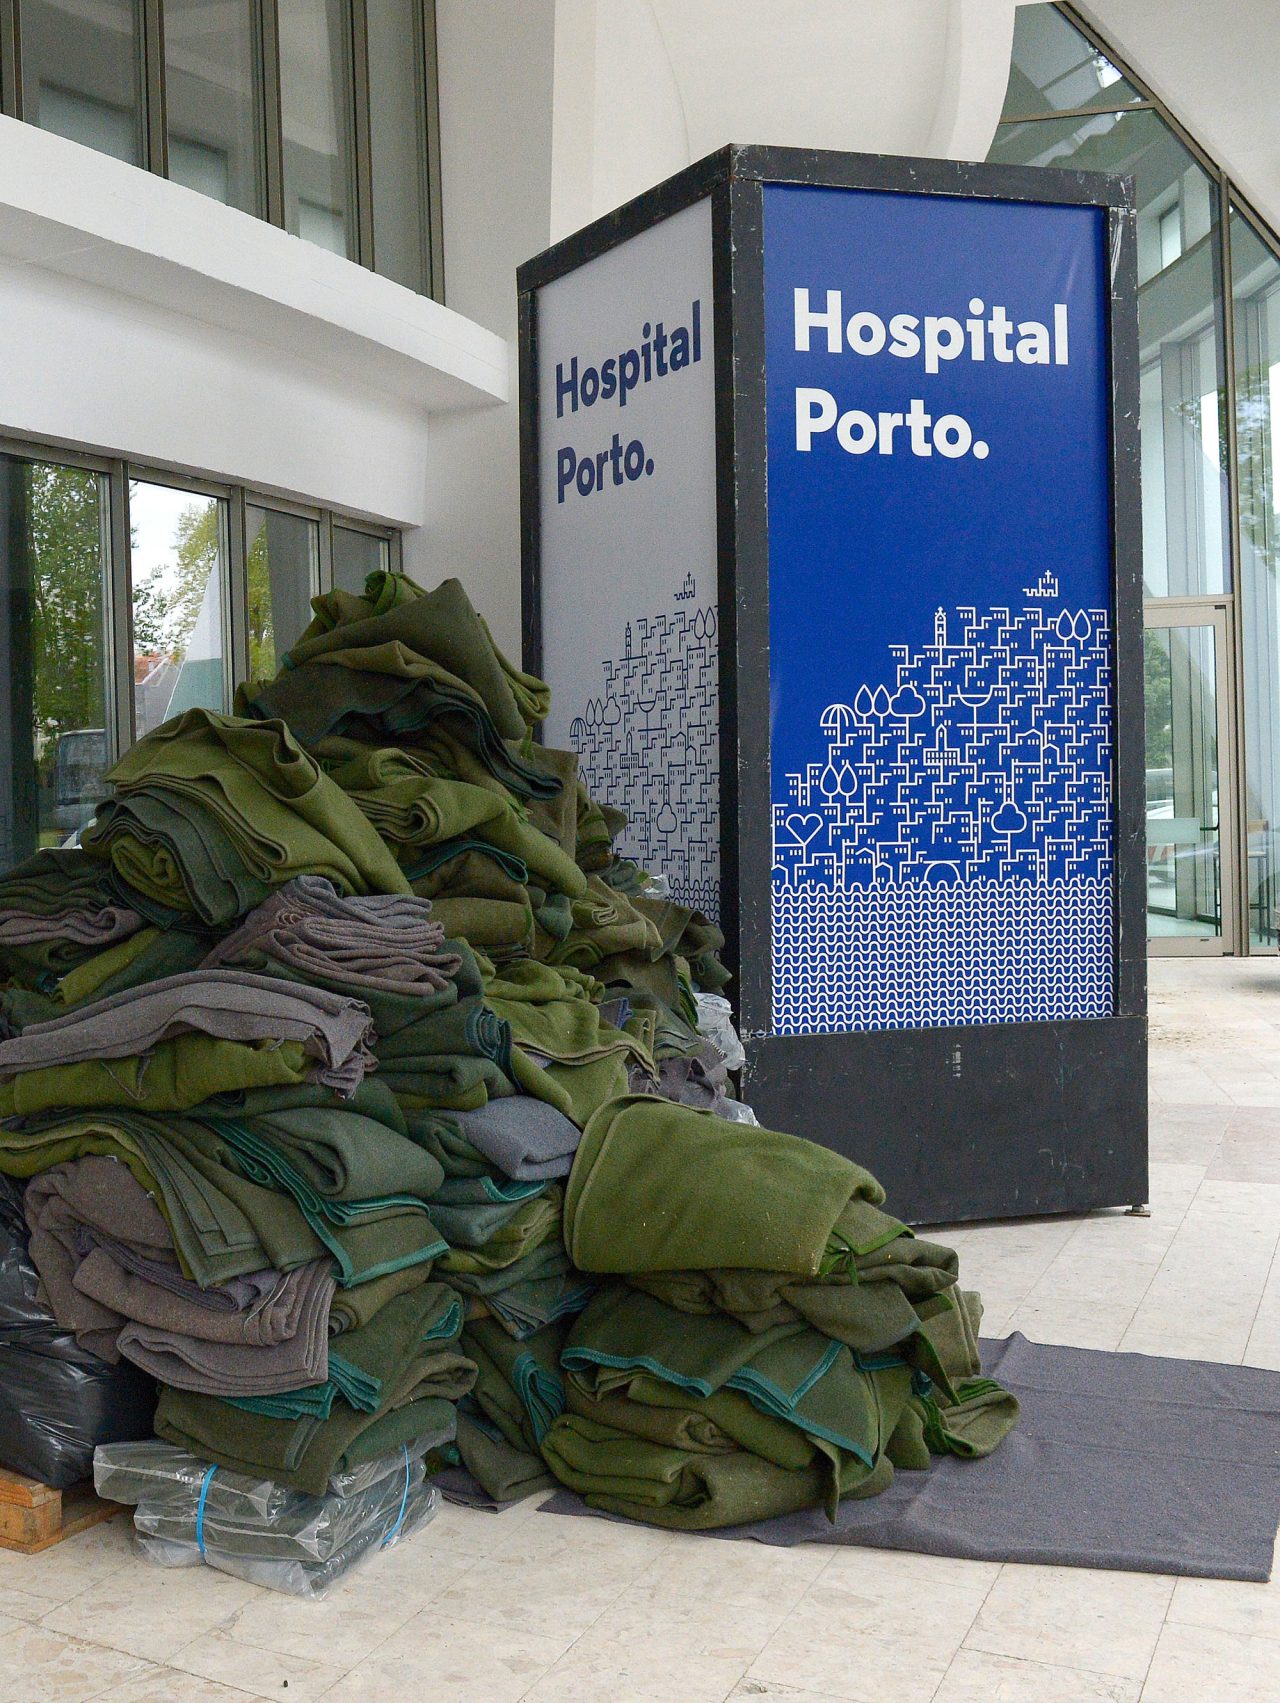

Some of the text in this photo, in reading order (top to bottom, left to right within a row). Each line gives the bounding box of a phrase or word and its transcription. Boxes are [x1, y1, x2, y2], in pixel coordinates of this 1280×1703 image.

[555, 299, 702, 419] Hospital
[793, 287, 1069, 374] Hospital
[795, 387, 990, 460] Porto.
[557, 433, 655, 505] Porto.
